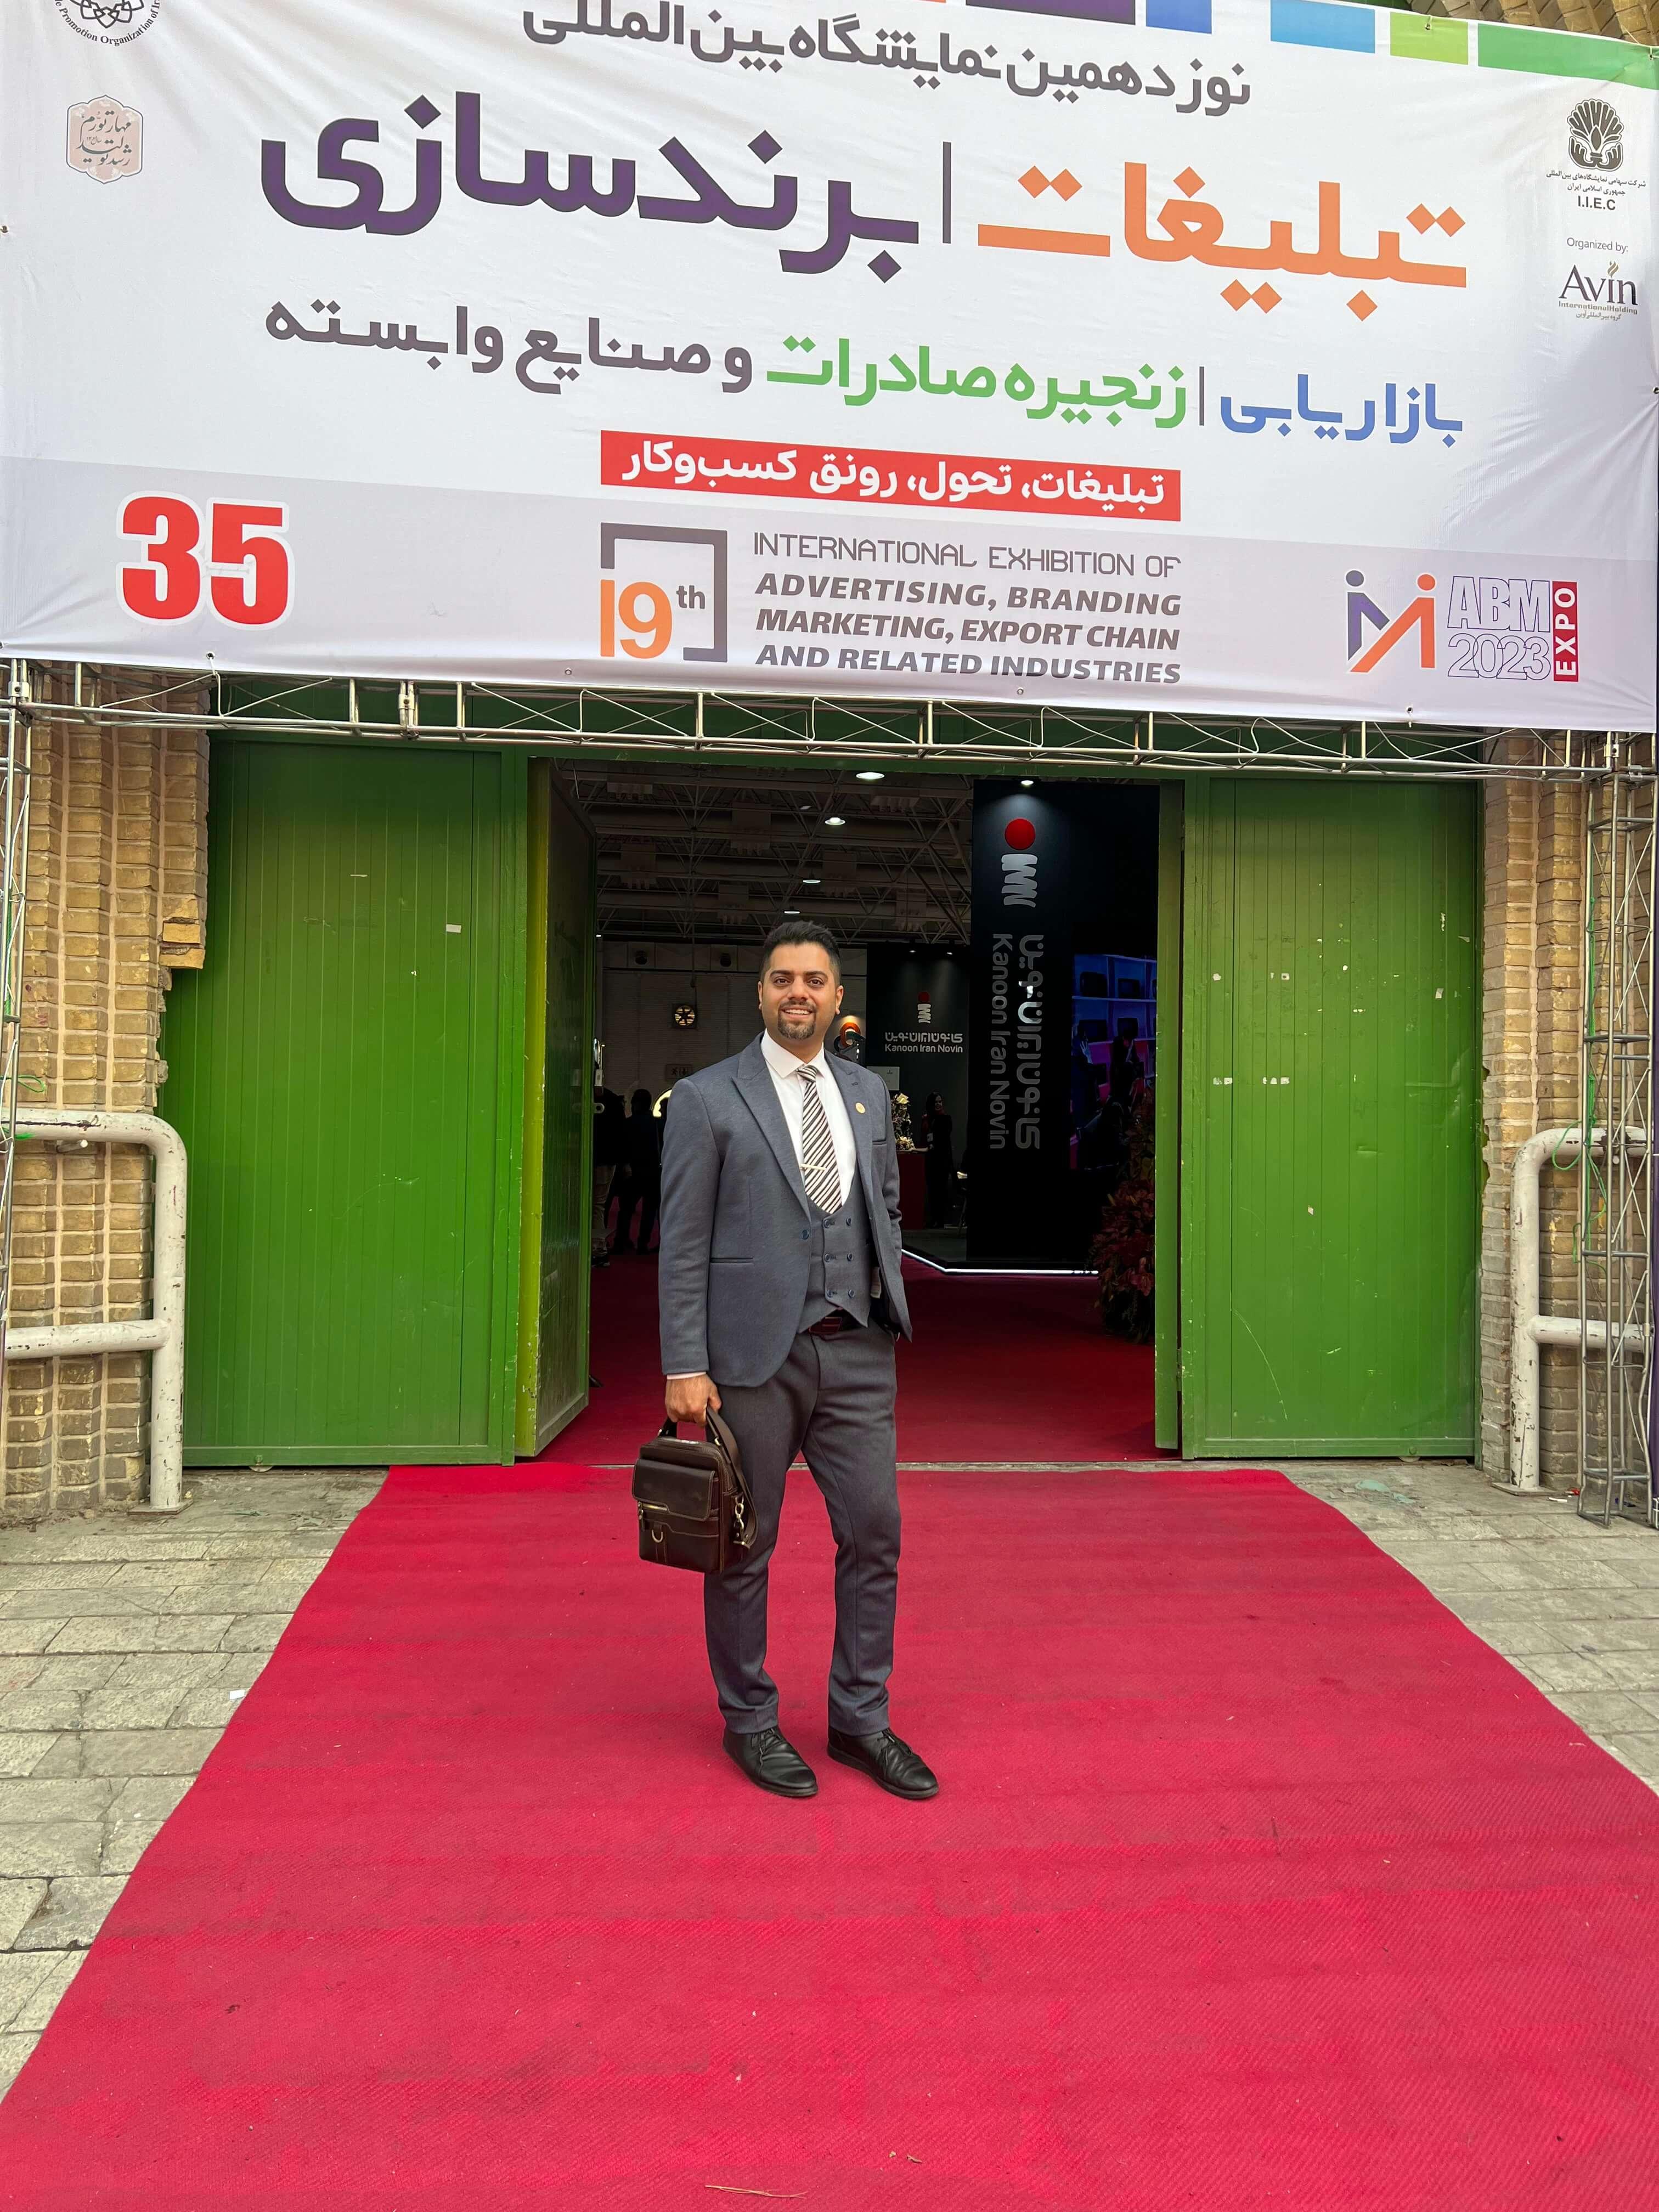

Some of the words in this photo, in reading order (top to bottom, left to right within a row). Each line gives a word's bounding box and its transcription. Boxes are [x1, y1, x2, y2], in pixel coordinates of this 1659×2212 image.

[59, 7, 98, 42] Promotion
[100, 18, 154, 47] Organization
[150, 8, 159, 18] of
[789, 13, 1001, 90] نمایشگاه
[1007, 48, 1250, 116] نوزدهمین
[1567, 183, 1581, 191] ایران
[1578, 196, 1616, 211] I.I.E.C
[1583, 184, 1602, 193] اسلامی
[1603, 188, 1626, 196] جمهوری
[1608, 178, 1627, 187] سهامی
[1628, 180, 1646, 189] شرکت
[978, 162, 1467, 322] تبلیغات
[1567, 238, 1613, 251] Organized
[1616, 242, 1629, 254] by:
[1558, 261, 1638, 306] Avin
[266, 299, 503, 373] وابسته
[516, 317, 710, 395] صنایع
[721, 347, 752, 393] و
[767, 335, 997, 406] صادرات
[1004, 363, 1186, 428] زنجیره
[1220, 375, 1463, 448] بازاریابی
[809, 453, 898, 498] رونق
[907, 461, 1012, 503] تحول،
[1021, 470, 1165, 513] تبلیغات،
[122, 496, 289, 625] 35
[754, 532, 978, 567] INTERNATIONAL
[989, 546, 1134, 576] EXHIBITION
[1146, 555, 1181, 578] OF
[754, 573, 997, 611] ADVERTISING,
[1007, 586, 1181, 616] BRANDING
[1447, 576, 1551, 633] ABM
[756, 608, 953, 644] MARKETING,
[961, 619, 1082, 646] EXPORT
[1087, 626, 1180, 650] CHAIN
[1554, 587, 1577, 676] EXPO
[755, 645, 829, 667] AND
[838, 648, 982, 674] RELATED
[990, 656, 1181, 684] INDUSTRIES
[1447, 633, 1551, 680] 2023
[991, 934, 1013, 1024] Kanoon
[885, 1044, 918, 1052] Kanoon
[920, 1044, 936, 1052] Iran
[938, 1045, 963, 1053] Novin
[991, 1031, 1011, 1074] Iran
[990, 1081, 1009, 1149] Novin
